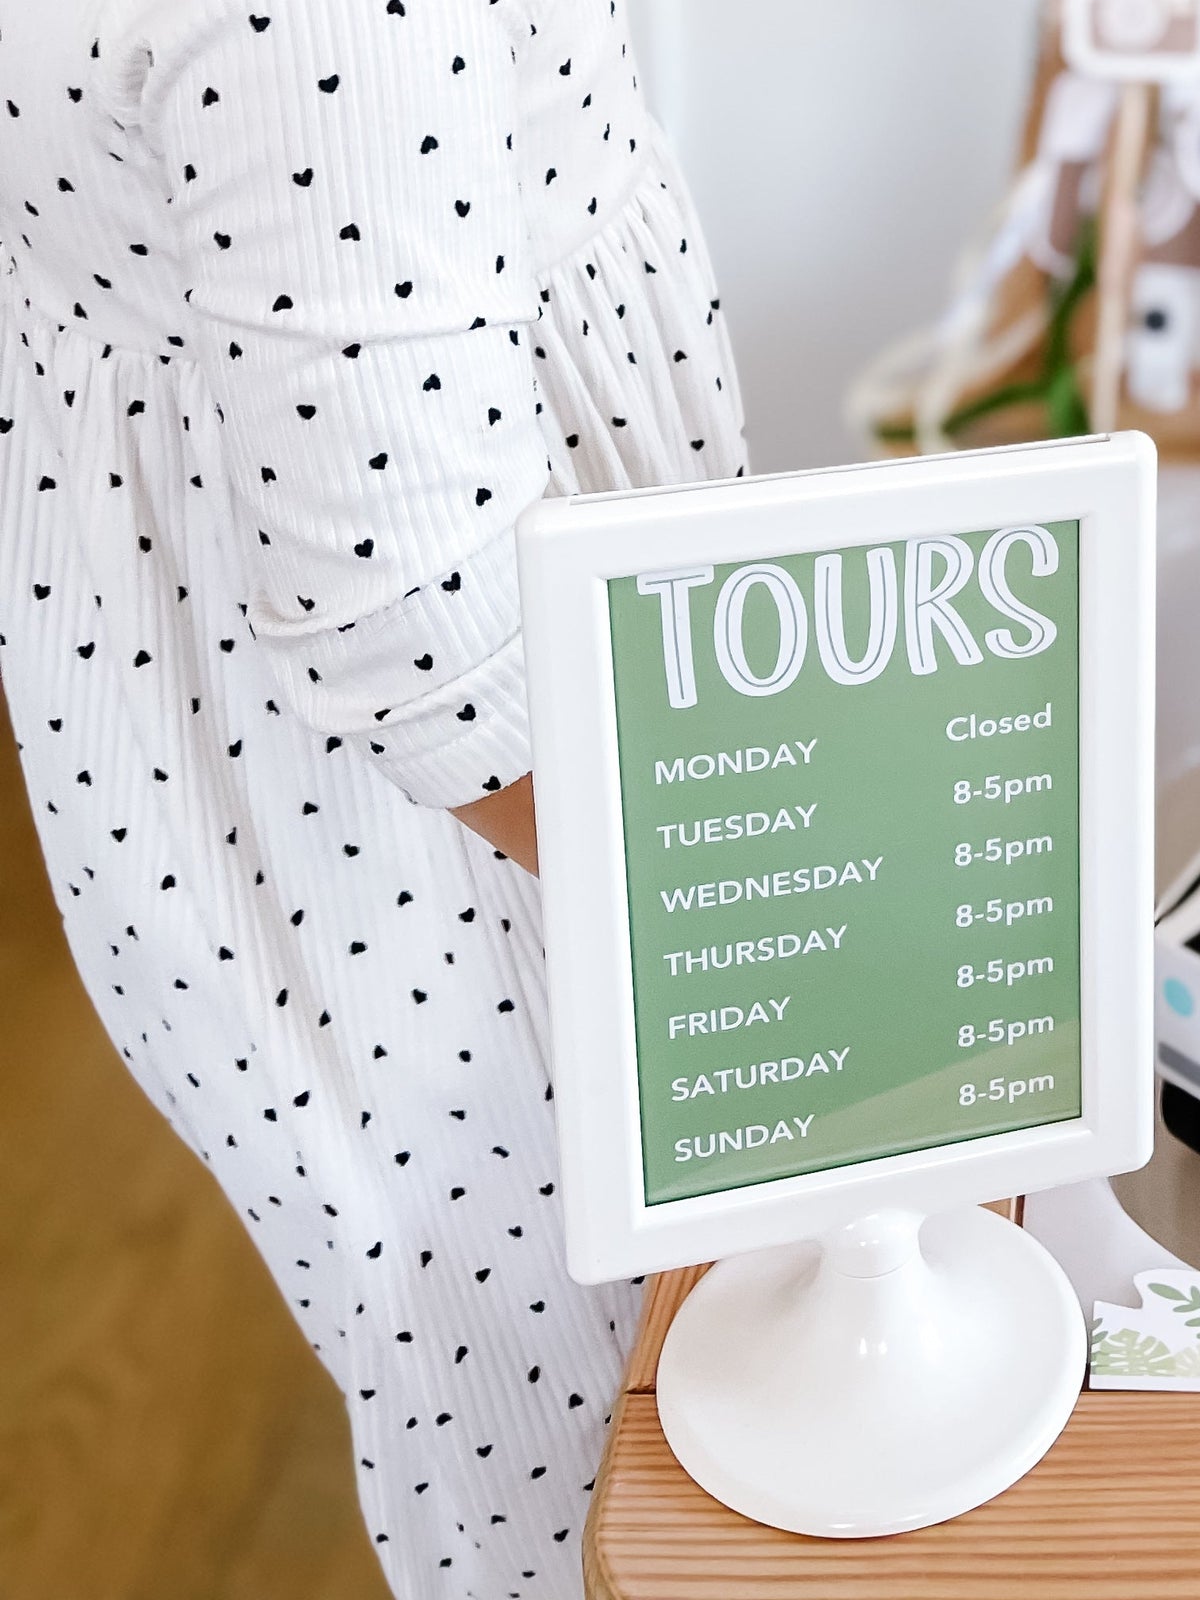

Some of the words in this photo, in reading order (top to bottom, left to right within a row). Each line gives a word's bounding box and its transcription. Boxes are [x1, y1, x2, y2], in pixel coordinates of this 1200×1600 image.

[637, 524, 1059, 709] TOURS
[654, 738, 818, 785] MONDAY
[945, 702, 1052, 743] Closed
[656, 803, 818, 850] TUESDAY
[953, 772, 1053, 806] 8-5pm
[659, 856, 884, 913] WEDNESDAY
[954, 834, 1054, 868] 8-5pm
[663, 925, 848, 977] THURSDAY
[955, 895, 1054, 929] 8-5pm
[668, 996, 791, 1040] FRIDAY
[956, 956, 1055, 990] 8-5pm
[671, 1046, 850, 1102] SATURDAY
[957, 1015, 1055, 1049] 8-5pm
[674, 1114, 815, 1163] SUNDAY
[958, 1074, 1055, 1107] 8-5pm
